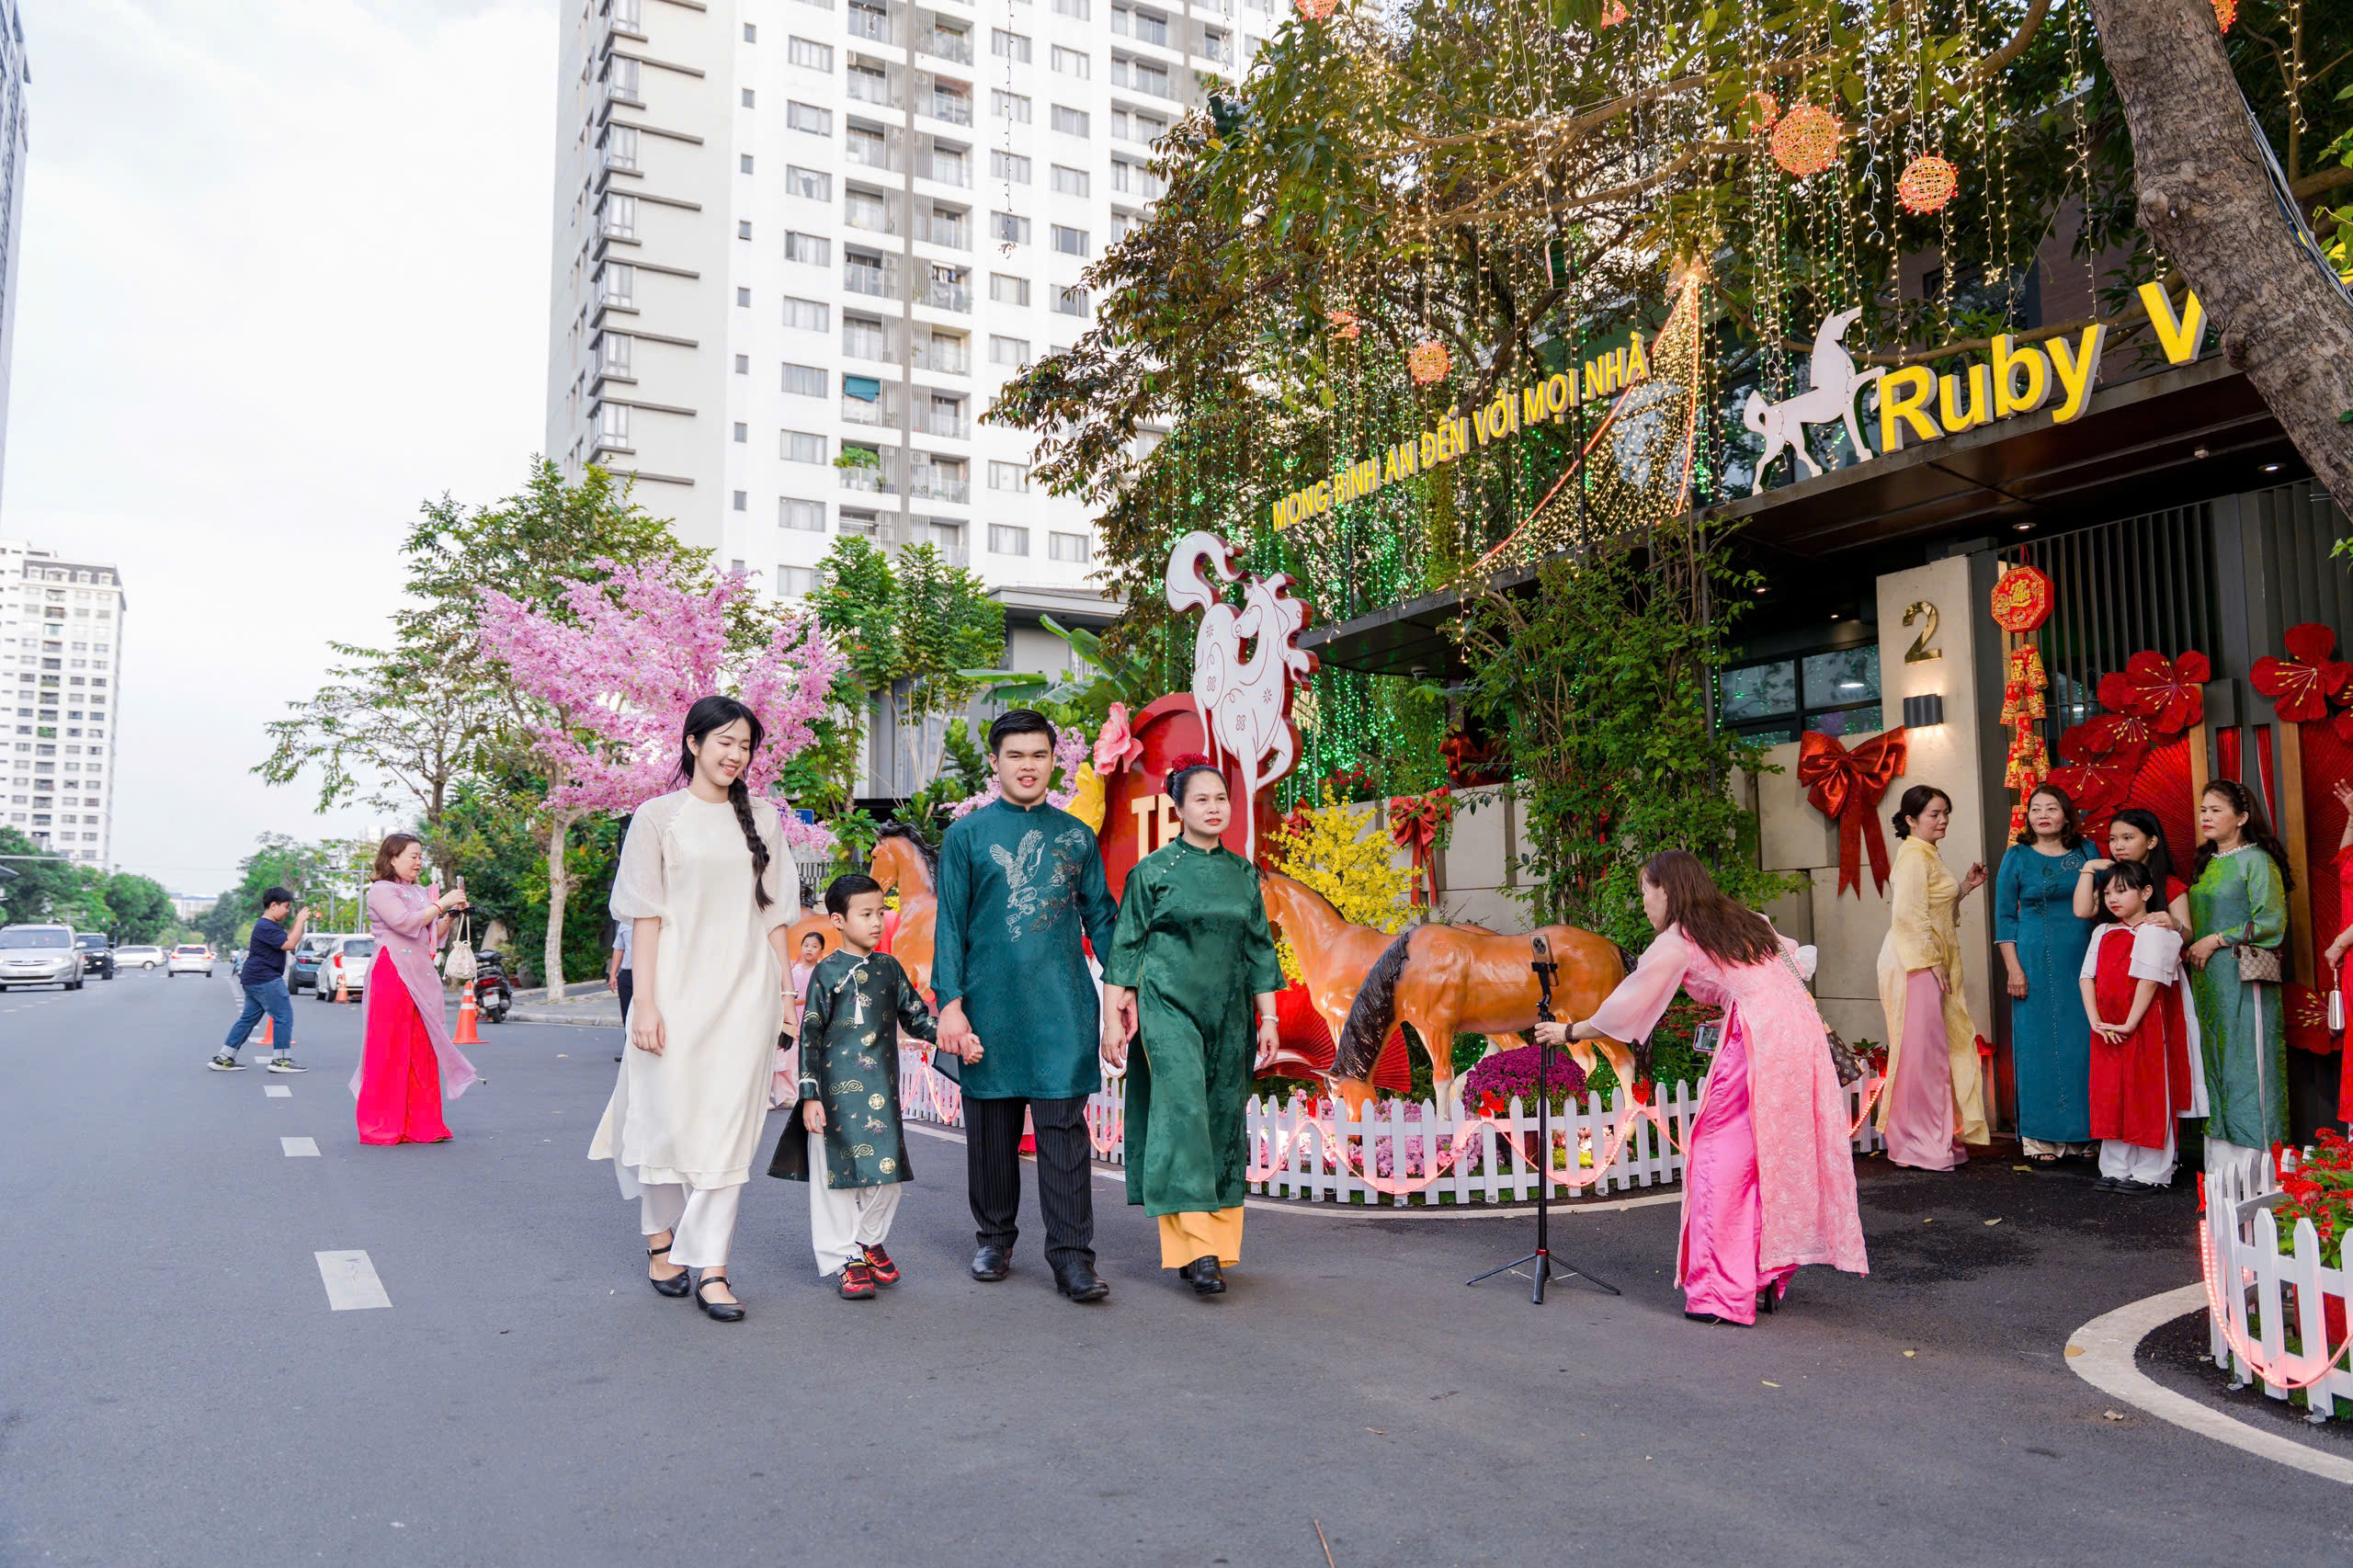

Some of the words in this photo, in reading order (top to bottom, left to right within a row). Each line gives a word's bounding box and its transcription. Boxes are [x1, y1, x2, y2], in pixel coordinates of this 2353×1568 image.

[1273, 480, 1333, 532] MONG
[1384, 439, 1418, 484] AN
[1421, 404, 1469, 469] ĐẾN
[1472, 388, 1519, 446] VỚI
[1524, 369, 1579, 426] MỌI
[1586, 331, 1651, 400] NHÀ
[1880, 324, 2105, 453] Ruby
[1903, 601, 1942, 663] 2
